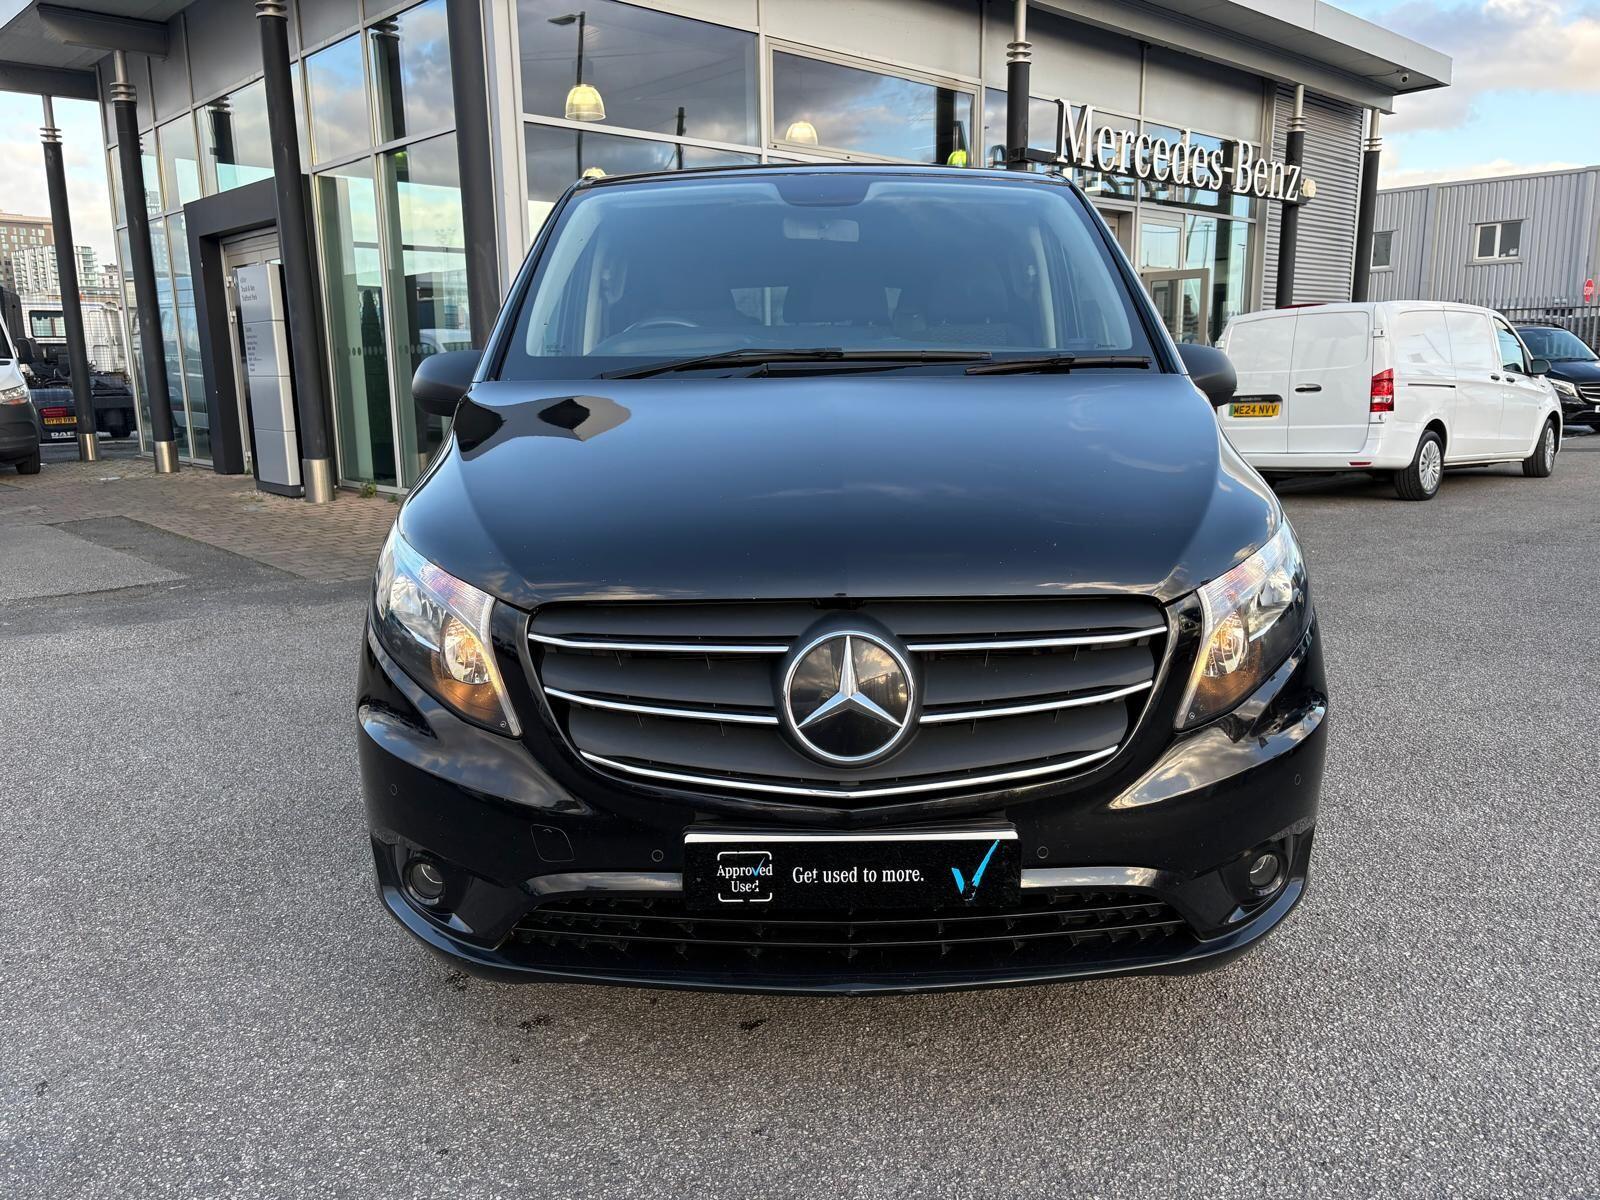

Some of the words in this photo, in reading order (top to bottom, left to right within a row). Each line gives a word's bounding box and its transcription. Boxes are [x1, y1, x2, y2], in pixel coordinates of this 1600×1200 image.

[1055, 98, 1301, 201] Mercedes-Benz
[717, 860, 773, 878] Approved
[792, 866, 817, 883] Get
[822, 866, 858, 883] used
[862, 867, 877, 883] to
[881, 867, 924, 883] more.
[731, 880, 759, 892] Used
